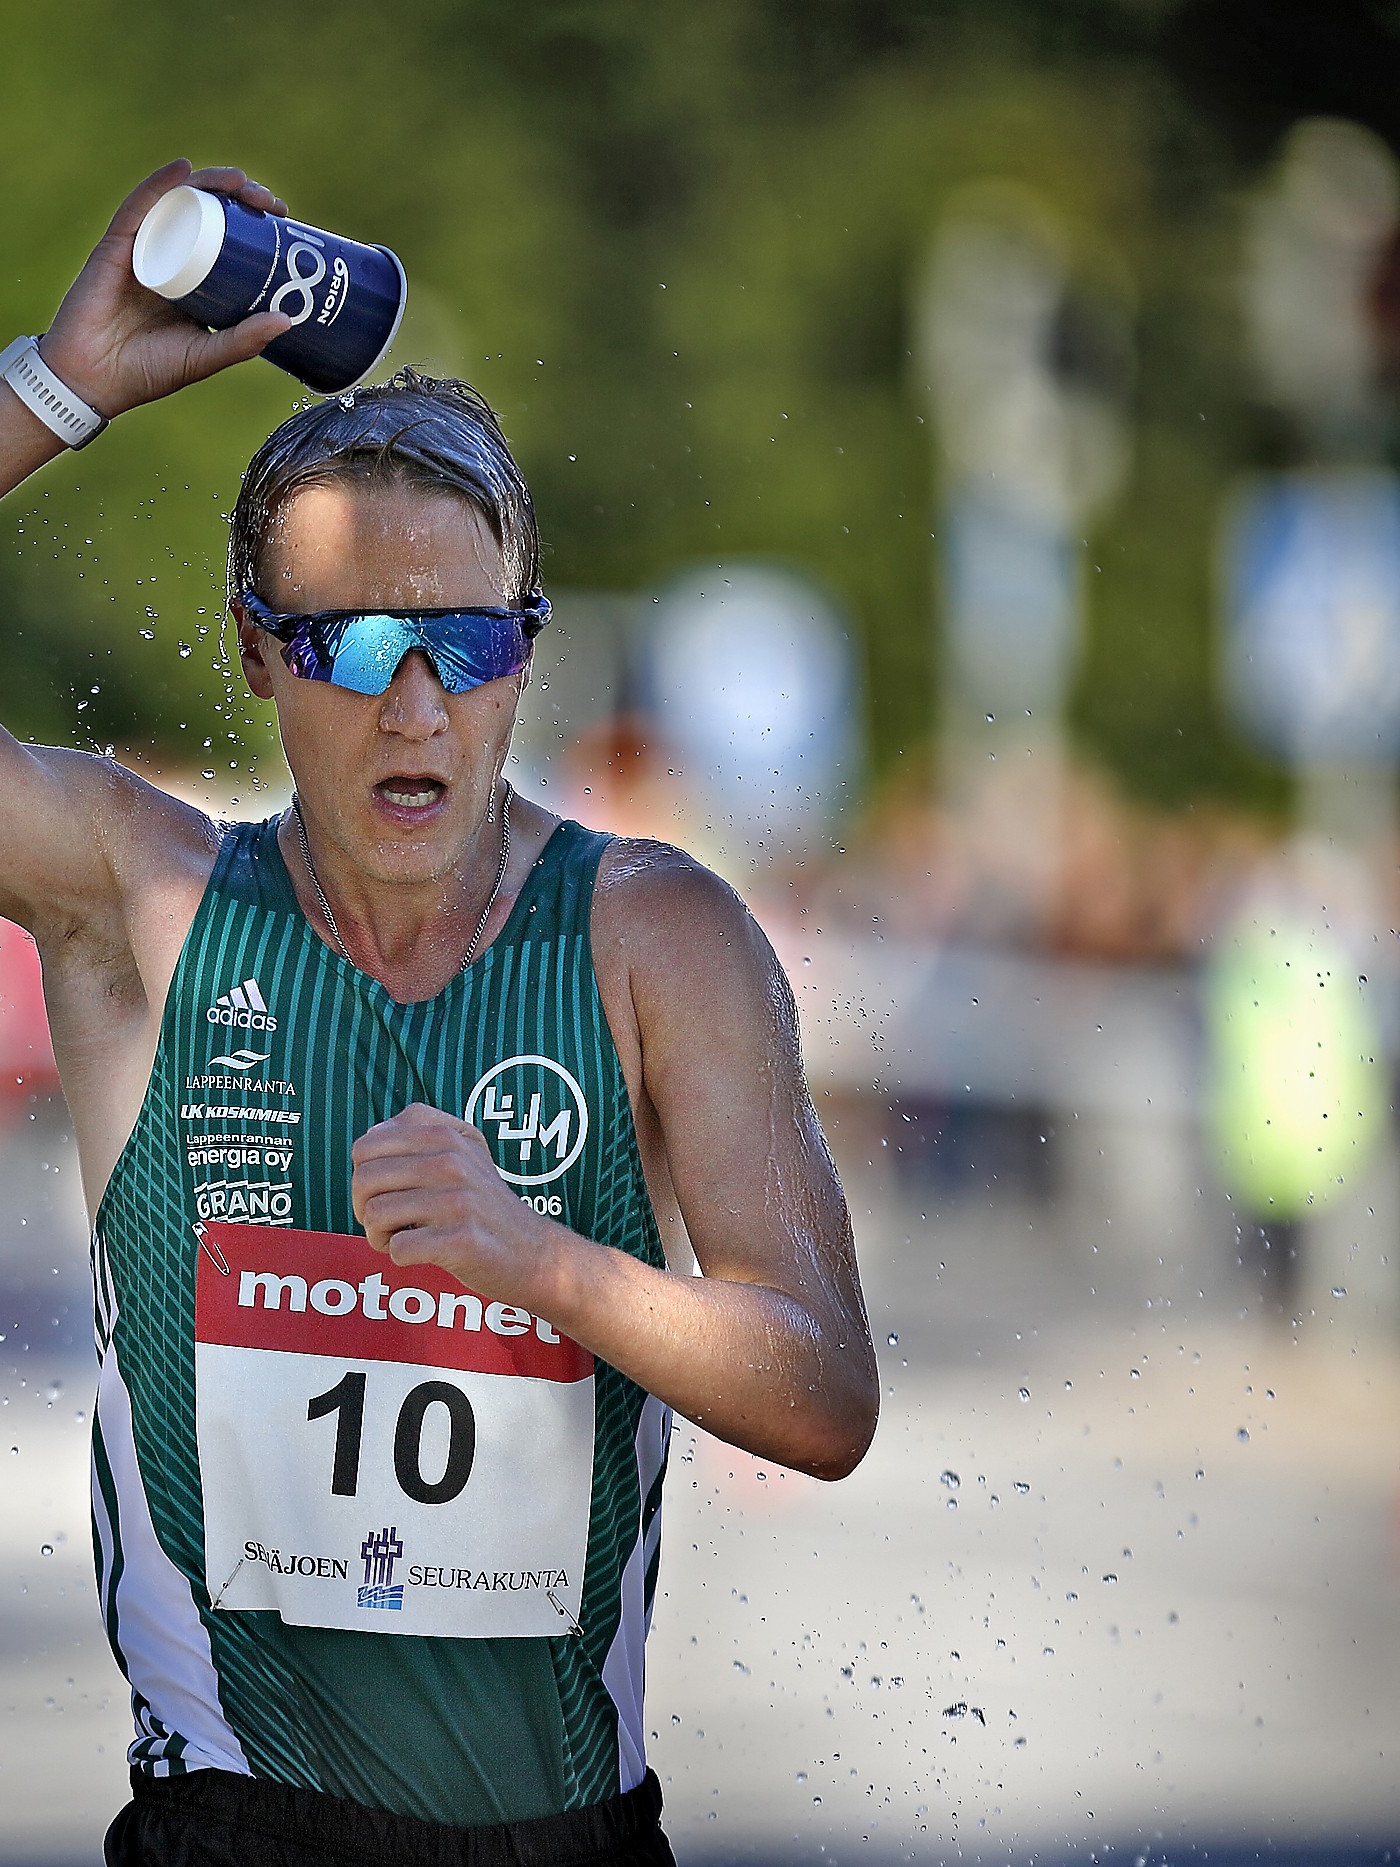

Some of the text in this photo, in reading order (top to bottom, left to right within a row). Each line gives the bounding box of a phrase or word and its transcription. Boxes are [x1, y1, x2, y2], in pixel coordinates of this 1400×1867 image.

[317, 256, 350, 326] ORION
[206, 1006, 278, 1032] adidas
[186, 1075, 297, 1096] LAPPEENRANTA
[205, 1106, 302, 1124] KOSKIMIES
[186, 1134, 293, 1146] Lappeenrannan
[188, 1149, 294, 1172] energia oy
[196, 1189, 293, 1219] GRANO
[238, 1270, 561, 1344] motonet
[306, 1371, 477, 1505] 10
[244, 1541, 570, 1592] SEÄJOEN SEURAKUNTA
